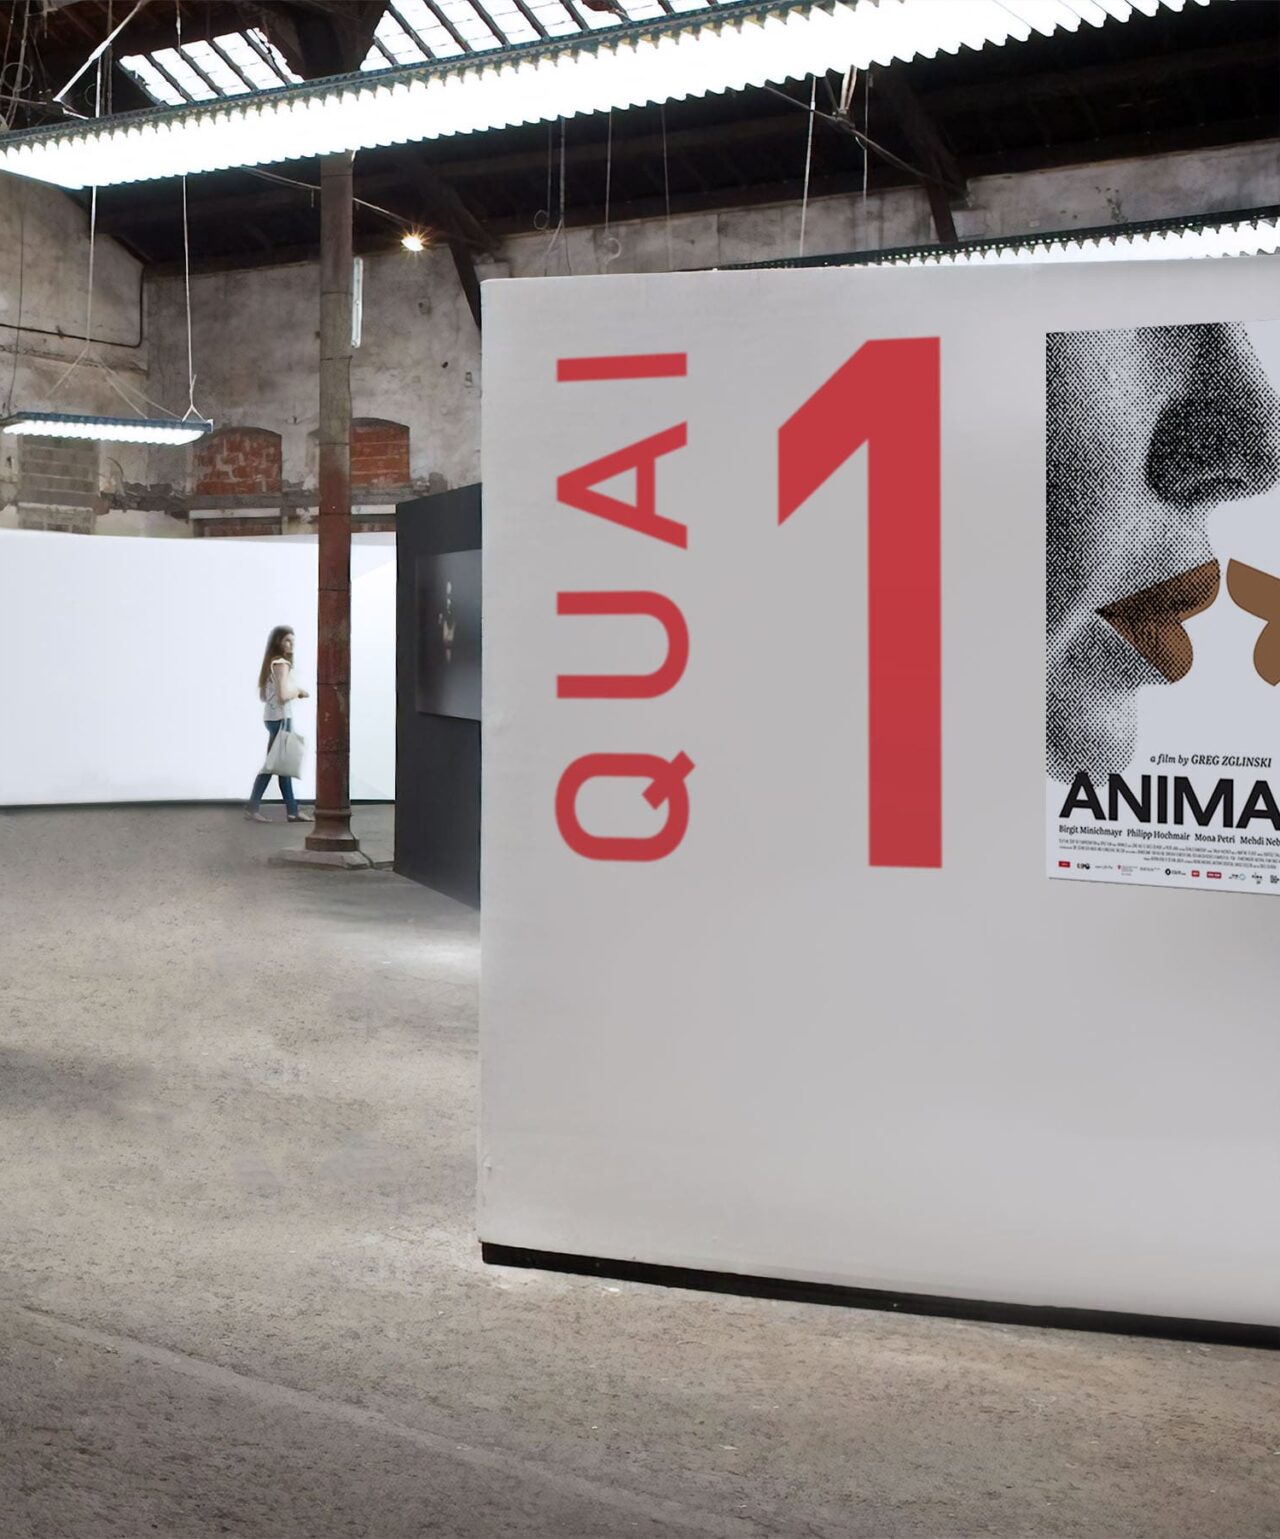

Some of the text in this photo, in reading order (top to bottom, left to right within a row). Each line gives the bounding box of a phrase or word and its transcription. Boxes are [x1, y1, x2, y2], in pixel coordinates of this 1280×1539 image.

[555, 336, 943, 869] QUAI 1
[1156, 753, 1176, 766] film
[1178, 754, 1189, 767] by
[1191, 754, 1220, 766] GREG
[1221, 755, 1272, 768] ZGLINSKI
[1059, 771, 1280, 831] ANIMA
[1059, 824, 1079, 835] Birgit
[1080, 825, 1122, 838] Minichmayr
[1127, 828, 1153, 840] Philipp
[1153, 829, 1190, 842] Hochmair
[1194, 833, 1216, 842] Mona
[1217, 833, 1236, 844] Petri
[1240, 835, 1264, 845] Mehdi
